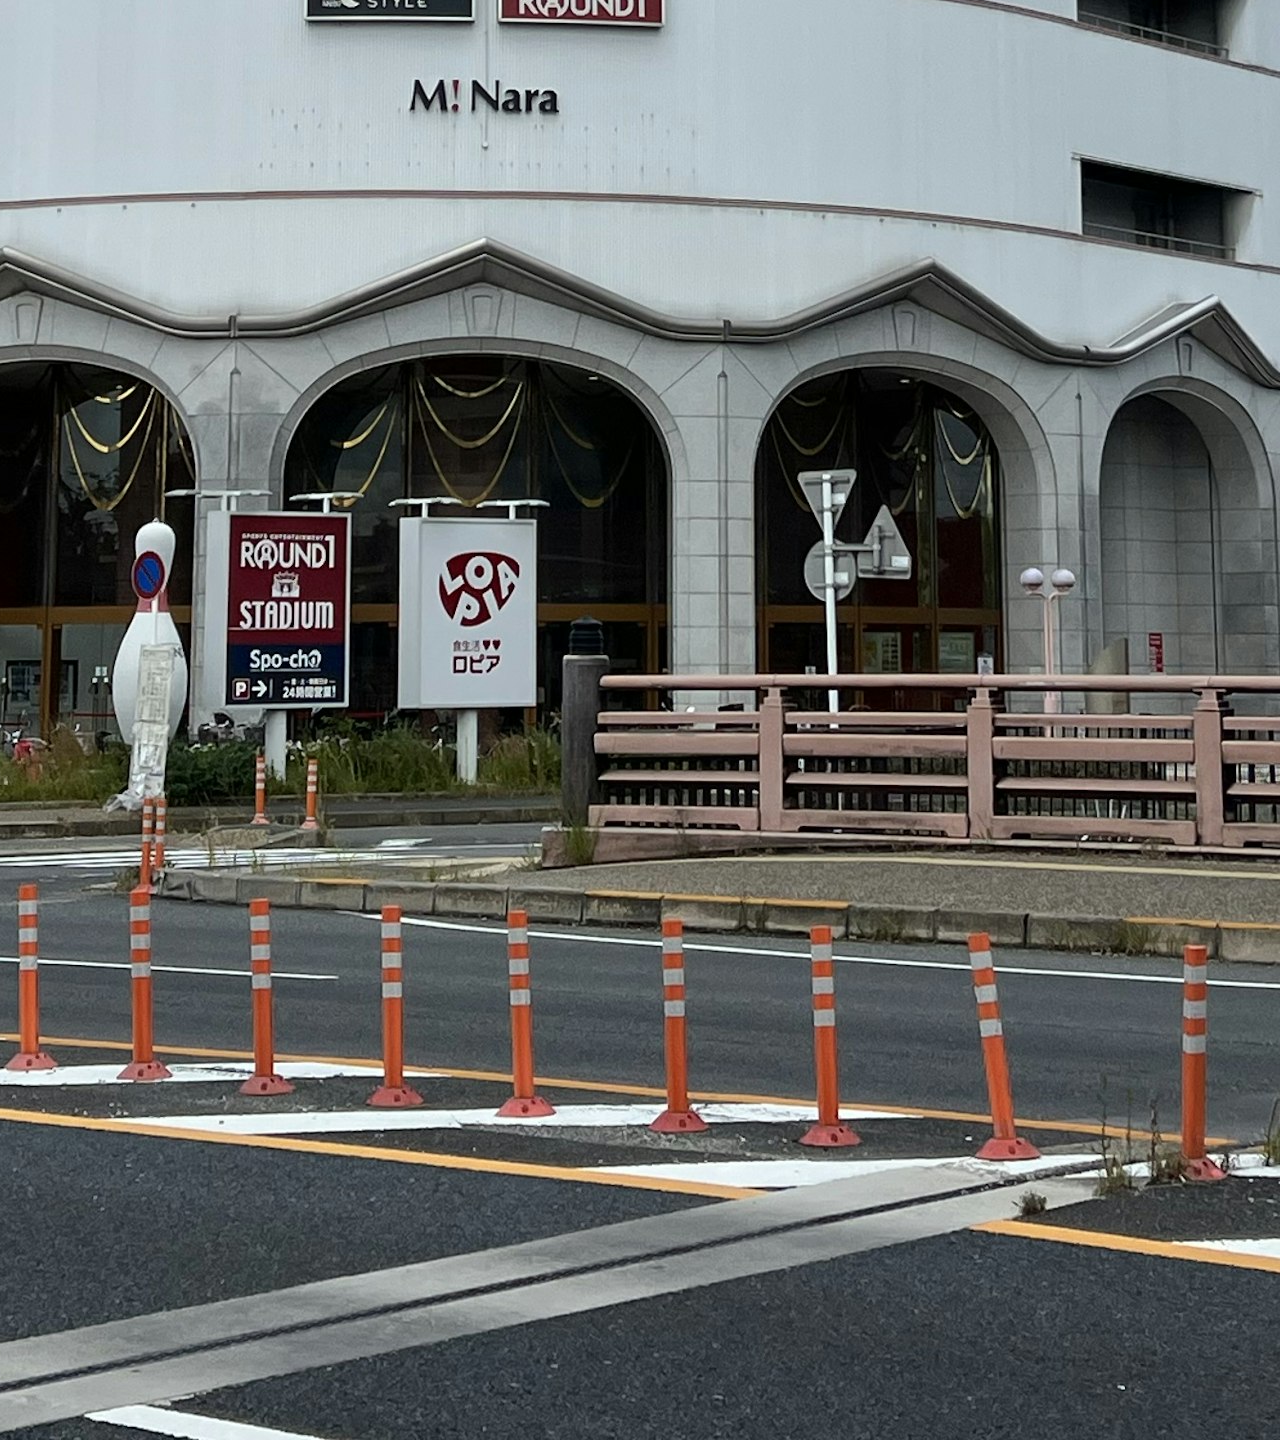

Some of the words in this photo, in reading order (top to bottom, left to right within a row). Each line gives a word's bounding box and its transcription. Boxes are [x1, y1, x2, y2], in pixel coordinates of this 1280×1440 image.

[240, 534, 336, 570] ROUND1
[239, 600, 334, 630] STADIUM
[452, 653, 501, 674] ロピア
